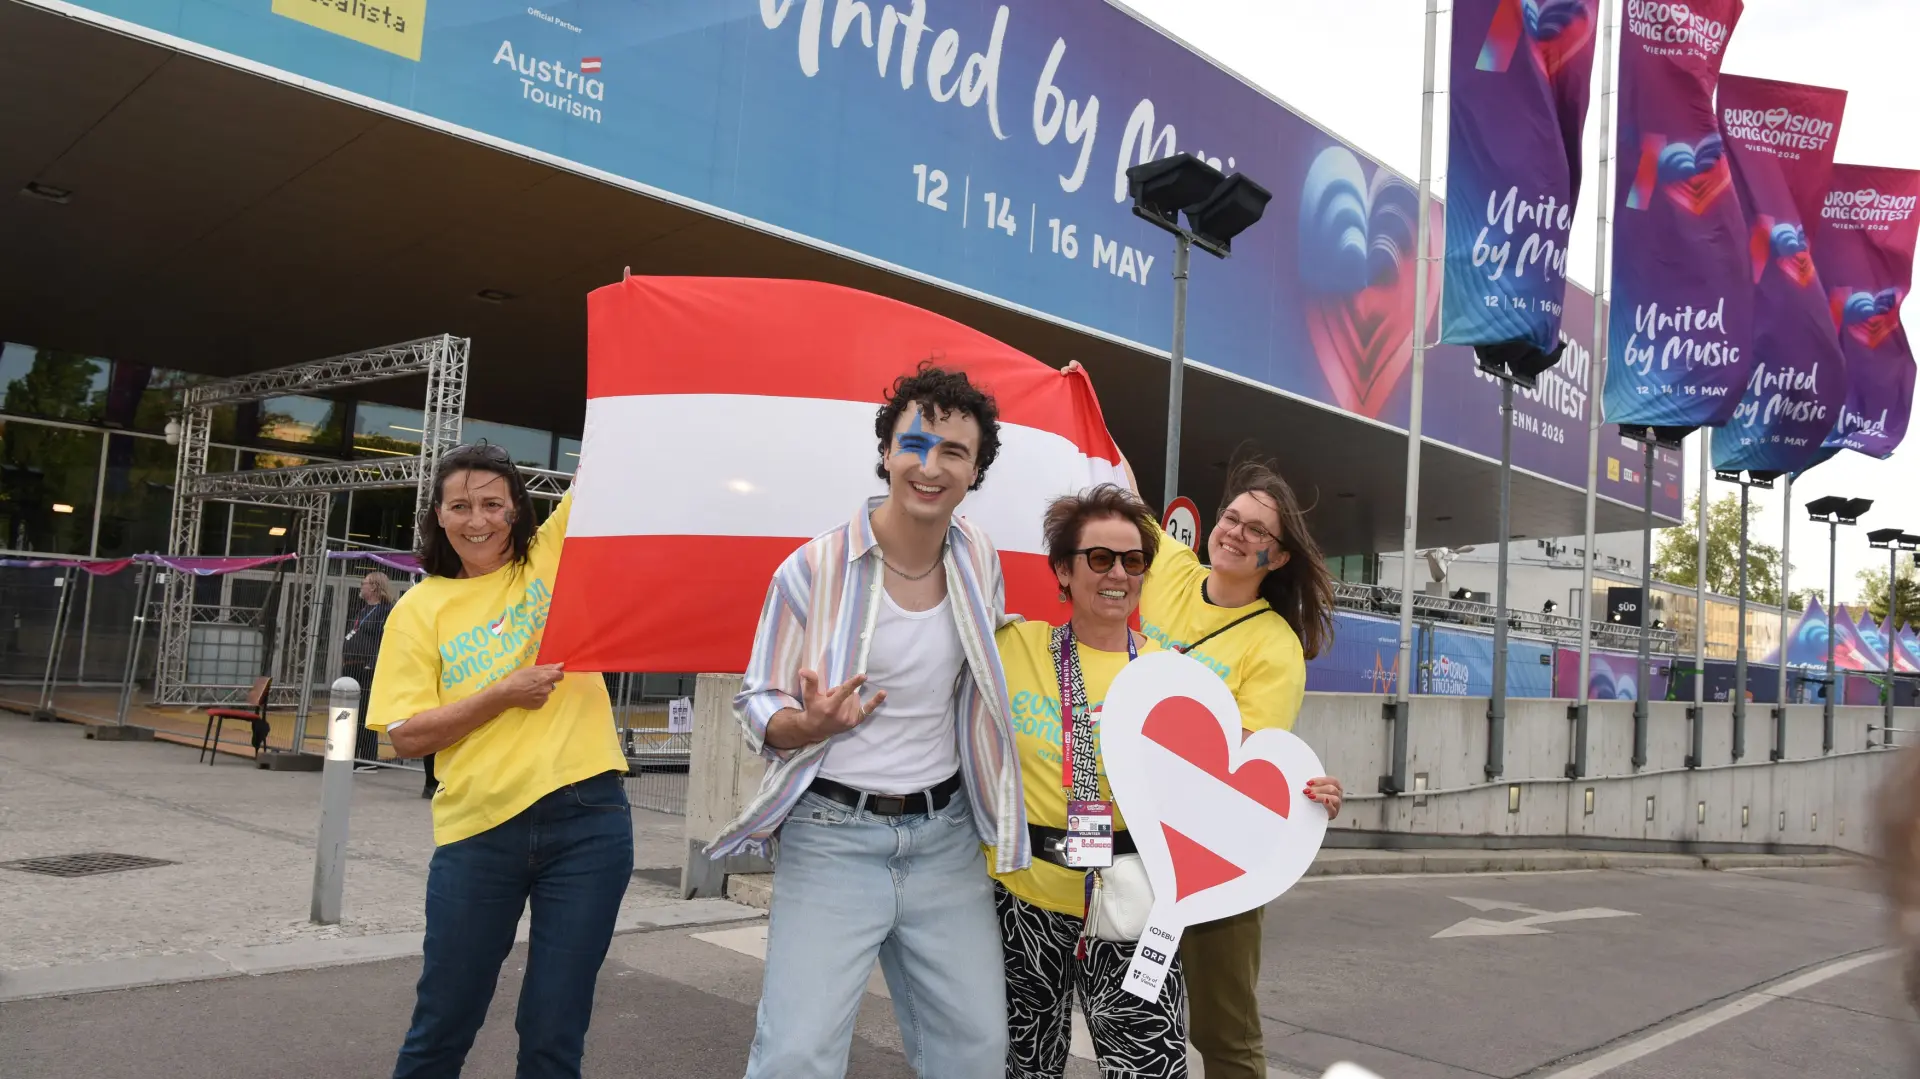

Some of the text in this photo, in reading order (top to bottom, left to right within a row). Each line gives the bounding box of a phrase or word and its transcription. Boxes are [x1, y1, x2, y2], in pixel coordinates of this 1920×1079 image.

[527, 6, 583, 34] Official Partner
[1629, 19, 1662, 41] SONG
[1643, 44, 1683, 56] VIENNA
[492, 40, 605, 101] Austria
[519, 77, 602, 124] Tourism
[1033, 36, 1099, 193] by
[1727, 125, 1828, 151] SONG CONTEST
[1745, 143, 1800, 160] VIENNA 2026
[1487, 186, 1571, 235] Unite
[1821, 206, 1912, 222] ONG CONTEST
[912, 163, 1155, 286] 12 14 16 MAY
[1472, 226, 1511, 281] by
[1484, 295, 1499, 307] 12
[1512, 297, 1527, 309] 14
[1540, 300, 1551, 312] 16
[1635, 297, 1727, 341] United
[1624, 333, 1655, 376] by
[1661, 336, 1740, 372] Music
[1636, 384, 1728, 397] 12 14 16 MAY
[1763, 393, 1827, 425] Music
[1541, 421, 1564, 444] 2026
[1740, 437, 1751, 446] 12
[1784, 436, 1808, 447] MAY
[1618, 602, 1637, 612] SÜD
[1161, 932, 1175, 942] EBU
[1144, 949, 1164, 962] ORF
[1141, 978, 1156, 988] Vienna
[1142, 973, 1152, 982] City
